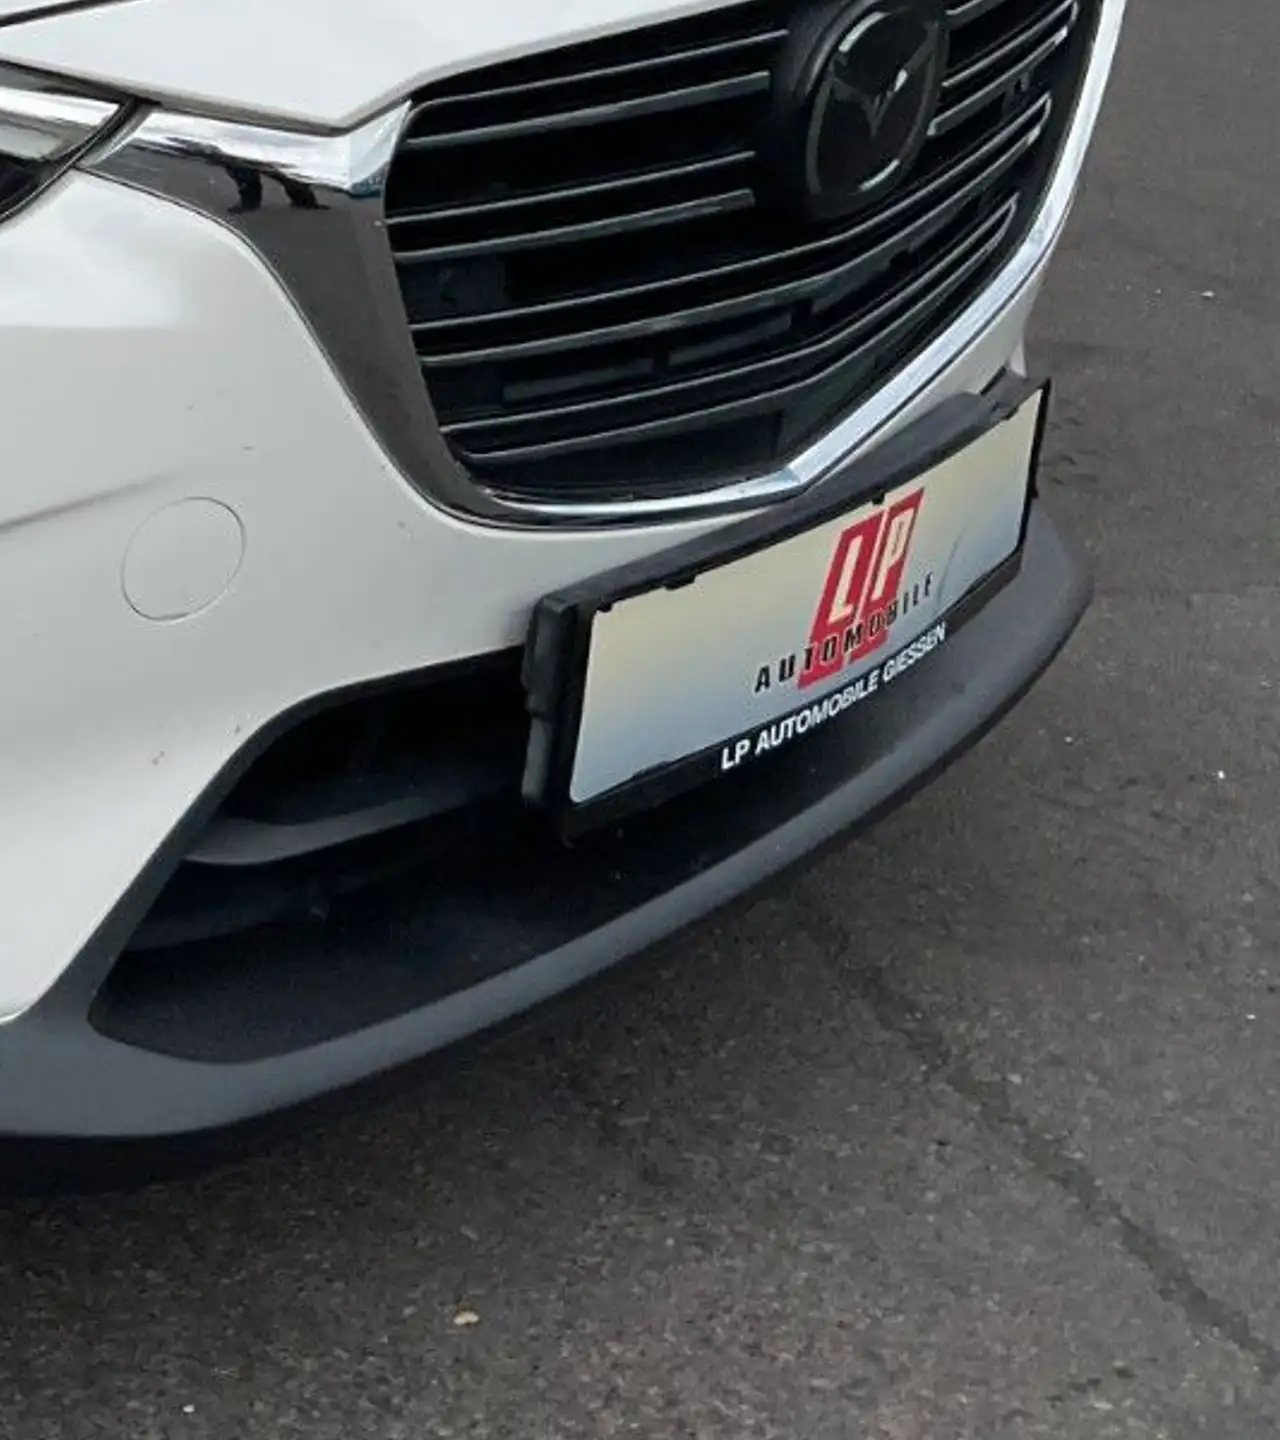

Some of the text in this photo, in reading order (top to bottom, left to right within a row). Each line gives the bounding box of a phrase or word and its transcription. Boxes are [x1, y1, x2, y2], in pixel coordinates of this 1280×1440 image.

[720, 621, 948, 771] LP AUTOMOBILE GIESSEN
[754, 570, 932, 694] AUTOMOBILE
